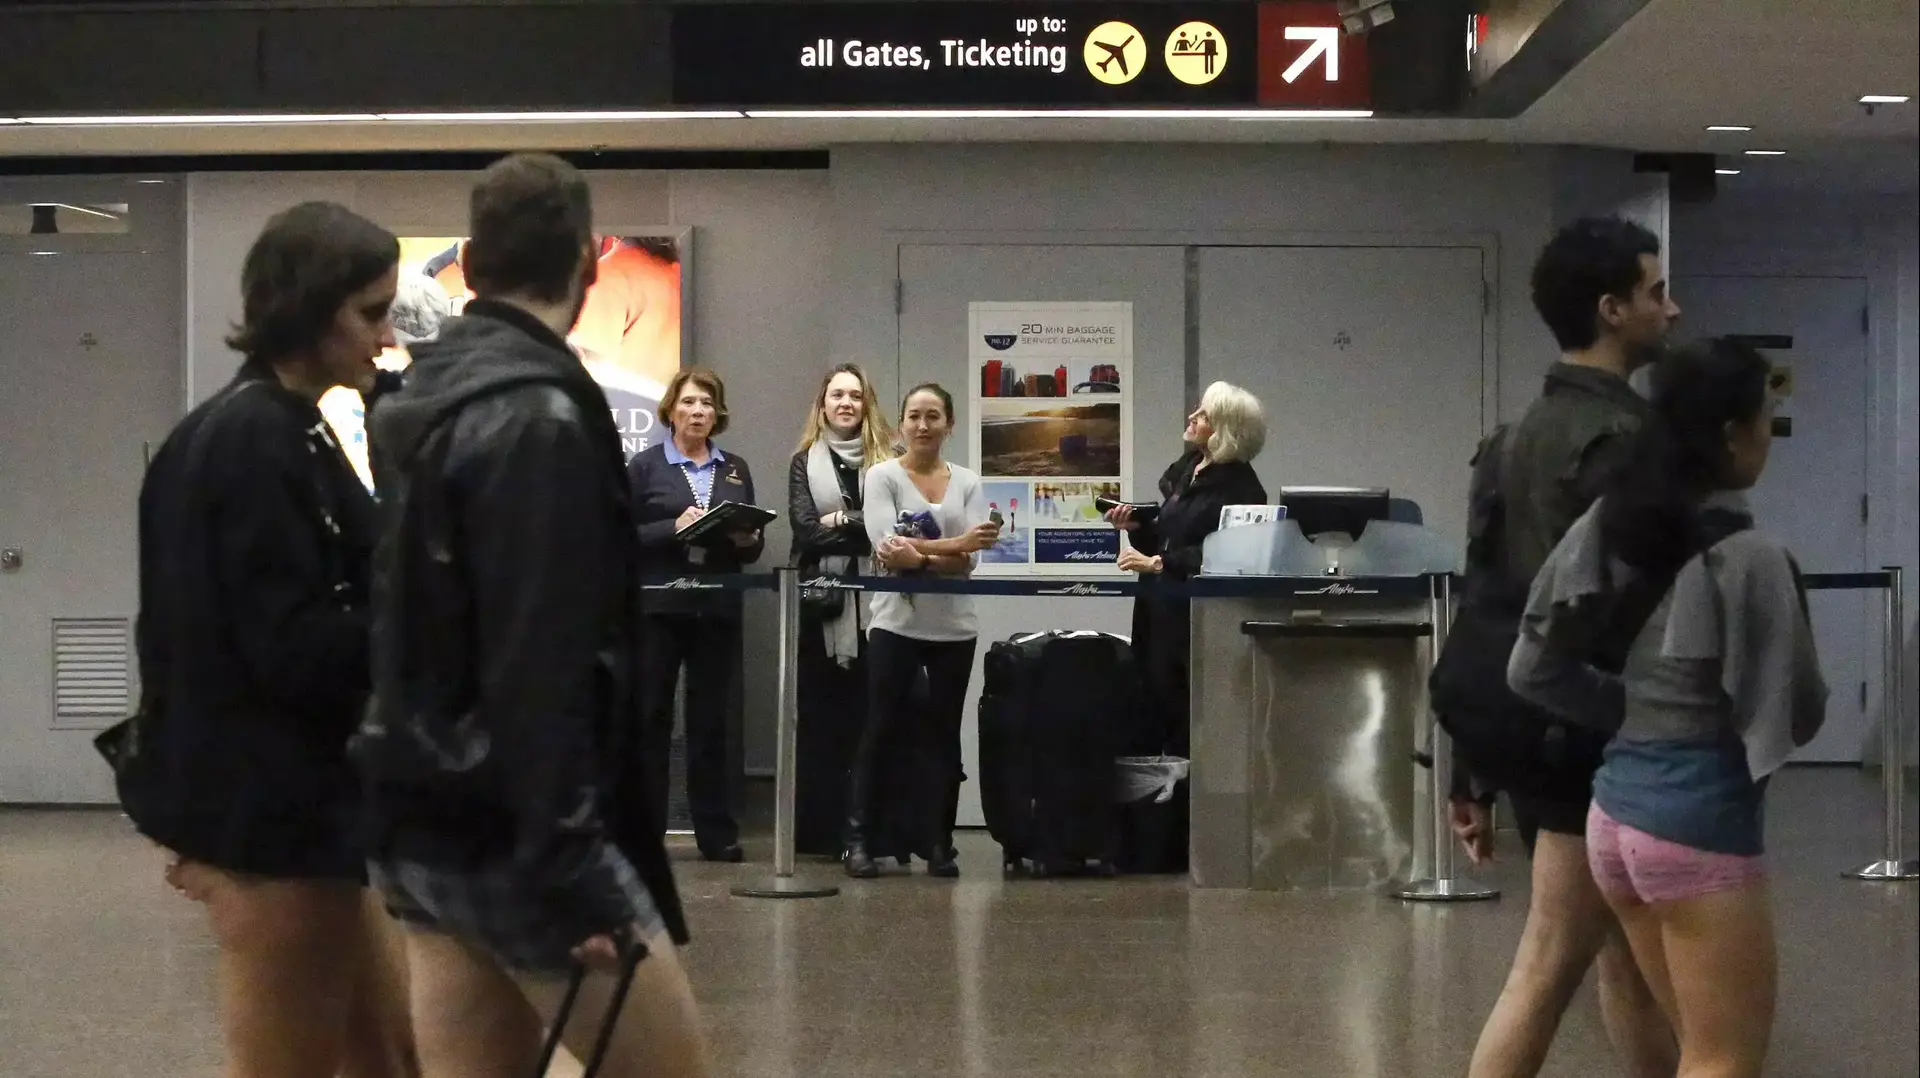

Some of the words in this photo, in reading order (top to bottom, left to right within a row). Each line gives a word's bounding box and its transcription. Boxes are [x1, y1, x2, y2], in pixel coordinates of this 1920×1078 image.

[1016, 18, 1038, 36] up
[1041, 16, 1067, 33] to:
[800, 38, 833, 67] all
[842, 40, 931, 71] Gates,
[939, 38, 1067, 74] Ticketing
[1021, 323, 1043, 334] 20
[1045, 326, 1064, 334] MIN
[1066, 326, 1116, 334] BAGGAGE
[1021, 337, 1058, 345] SERVICE
[1061, 337, 1116, 345] GUARANTEE
[664, 577, 700, 589] Alaska
[805, 576, 841, 589] Alaska
[1062, 583, 1100, 595] Alaska
[1319, 583, 1355, 595] Alaska
